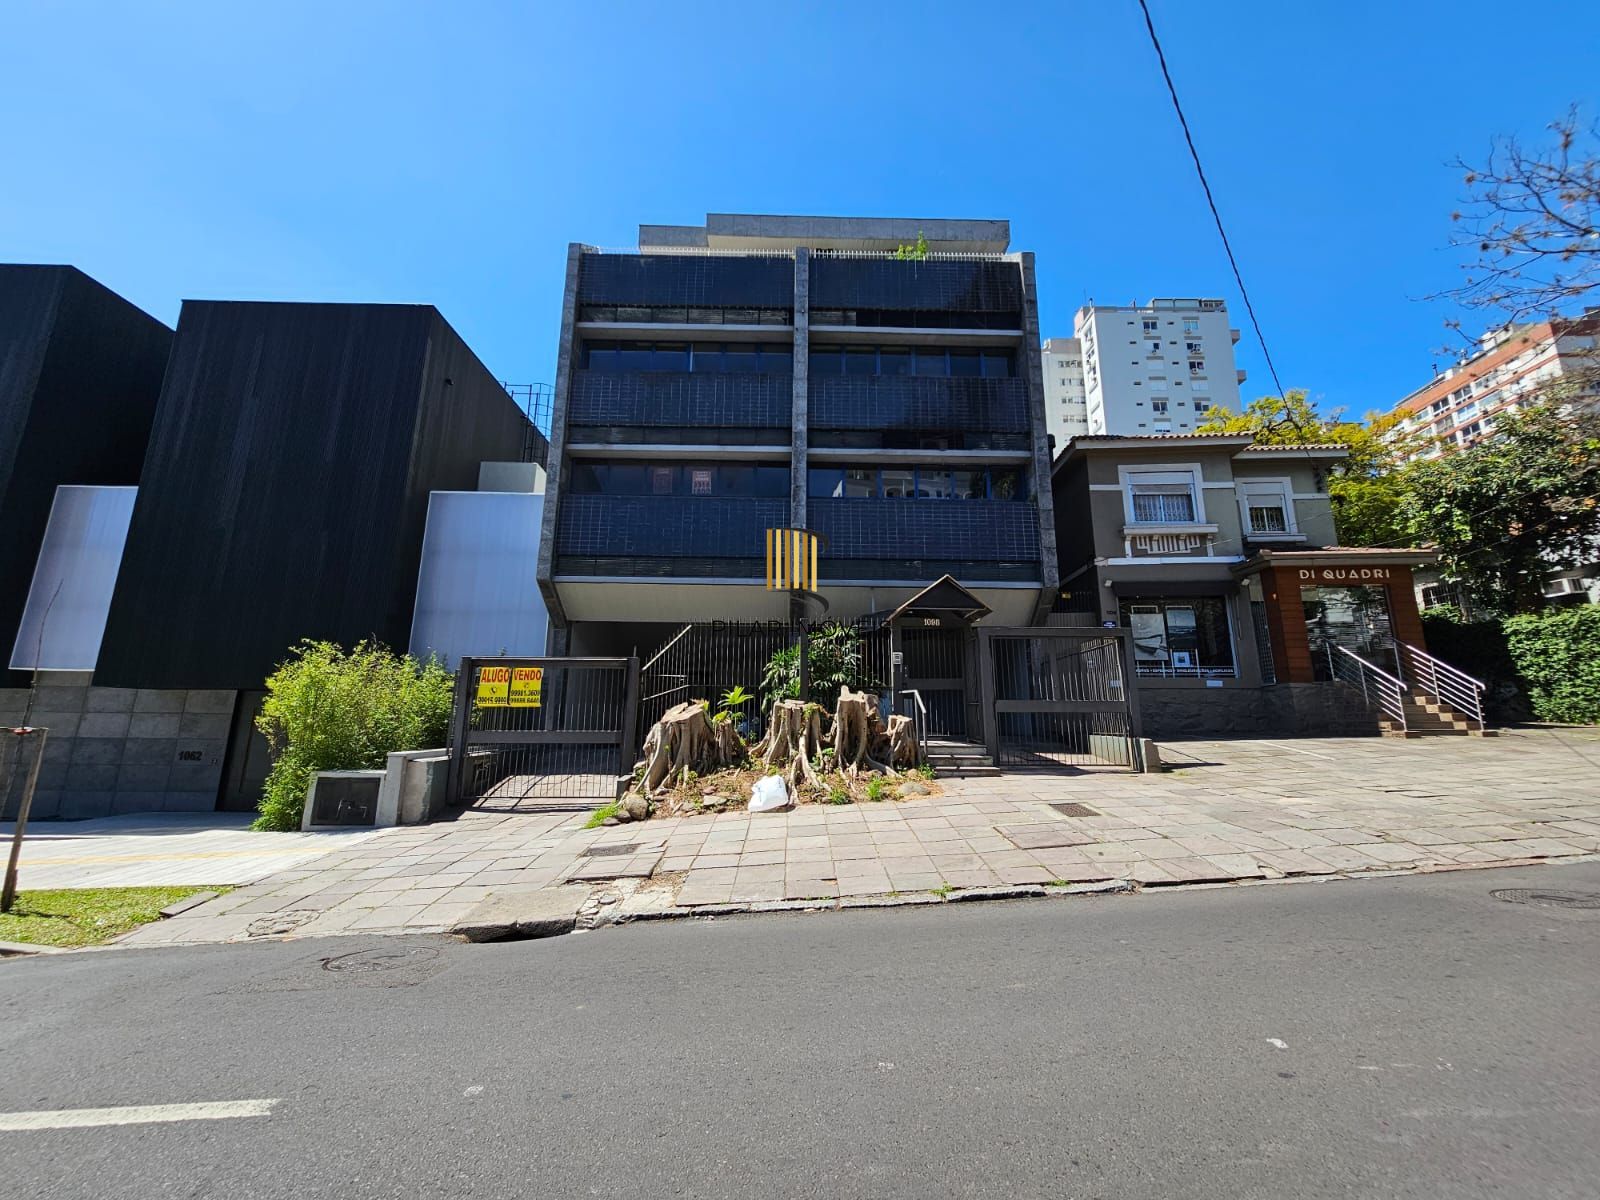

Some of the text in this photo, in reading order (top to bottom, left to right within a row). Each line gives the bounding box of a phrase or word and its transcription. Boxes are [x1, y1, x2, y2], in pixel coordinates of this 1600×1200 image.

[1299, 568, 1390, 580] DI QUADRI
[481, 669, 509, 682] ALUGO
[514, 670, 541, 680] VENDO
[178, 750, 202, 761] 1062
